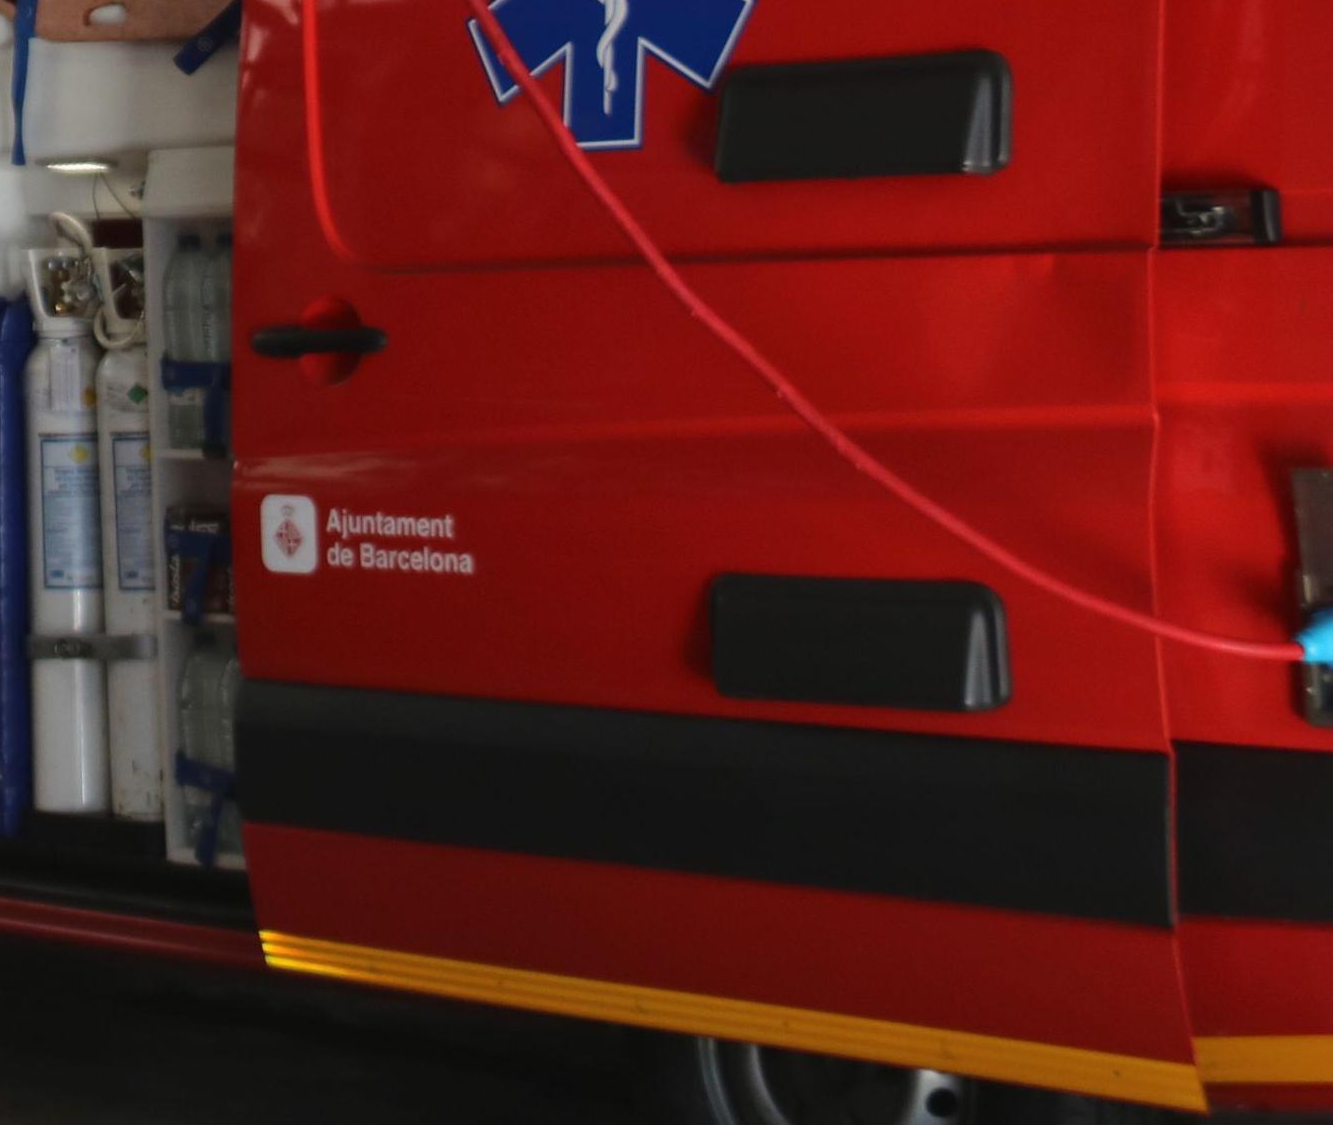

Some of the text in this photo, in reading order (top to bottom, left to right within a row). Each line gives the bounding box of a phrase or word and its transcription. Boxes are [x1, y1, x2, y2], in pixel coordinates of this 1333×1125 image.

[326, 507, 455, 539] Ajuntament
[326, 541, 475, 575] de Barcelona
